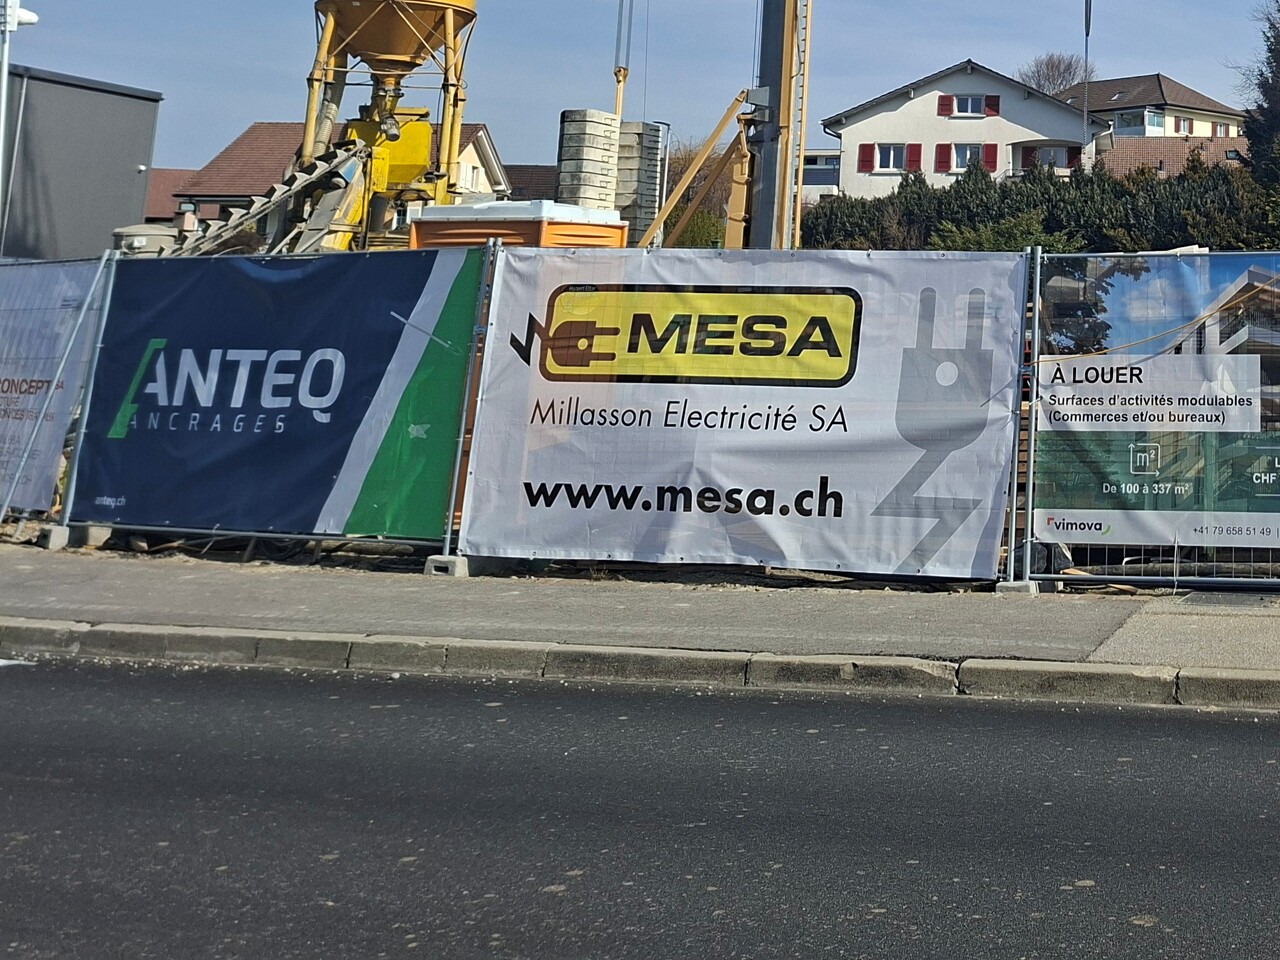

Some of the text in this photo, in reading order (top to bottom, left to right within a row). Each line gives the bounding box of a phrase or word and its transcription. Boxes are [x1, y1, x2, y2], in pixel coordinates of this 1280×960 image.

[626, 313, 843, 358] MESA
[127, 339, 346, 426] ANTEQ
[1050, 363, 1144, 384] À LOUER
[0, 378, 52, 396] ONCEPT
[1049, 394, 1105, 407] Surfaces
[1177, 394, 1254, 407] modulables
[130, 412, 286, 434] ANCRAGES
[530, 397, 849, 433] Millasson Electricité SA
[1049, 410, 1226, 426] (Commerces et/ou bureaux)
[1252, 473, 1277, 484] CHF
[522, 475, 845, 518] www.mesa.ch
[1102, 483, 1117, 494] De
[1120, 483, 1140, 494] 100
[1142, 483, 1149, 494] à
[1152, 483, 1172, 494] 337
[1054, 517, 1103, 531] vimova
[1193, 526, 1209, 535] +41
[1213, 526, 1224, 535] 79
[1226, 526, 1243, 536] 658
[1245, 526, 1256, 536] 51
[1259, 527, 1272, 536] 49
